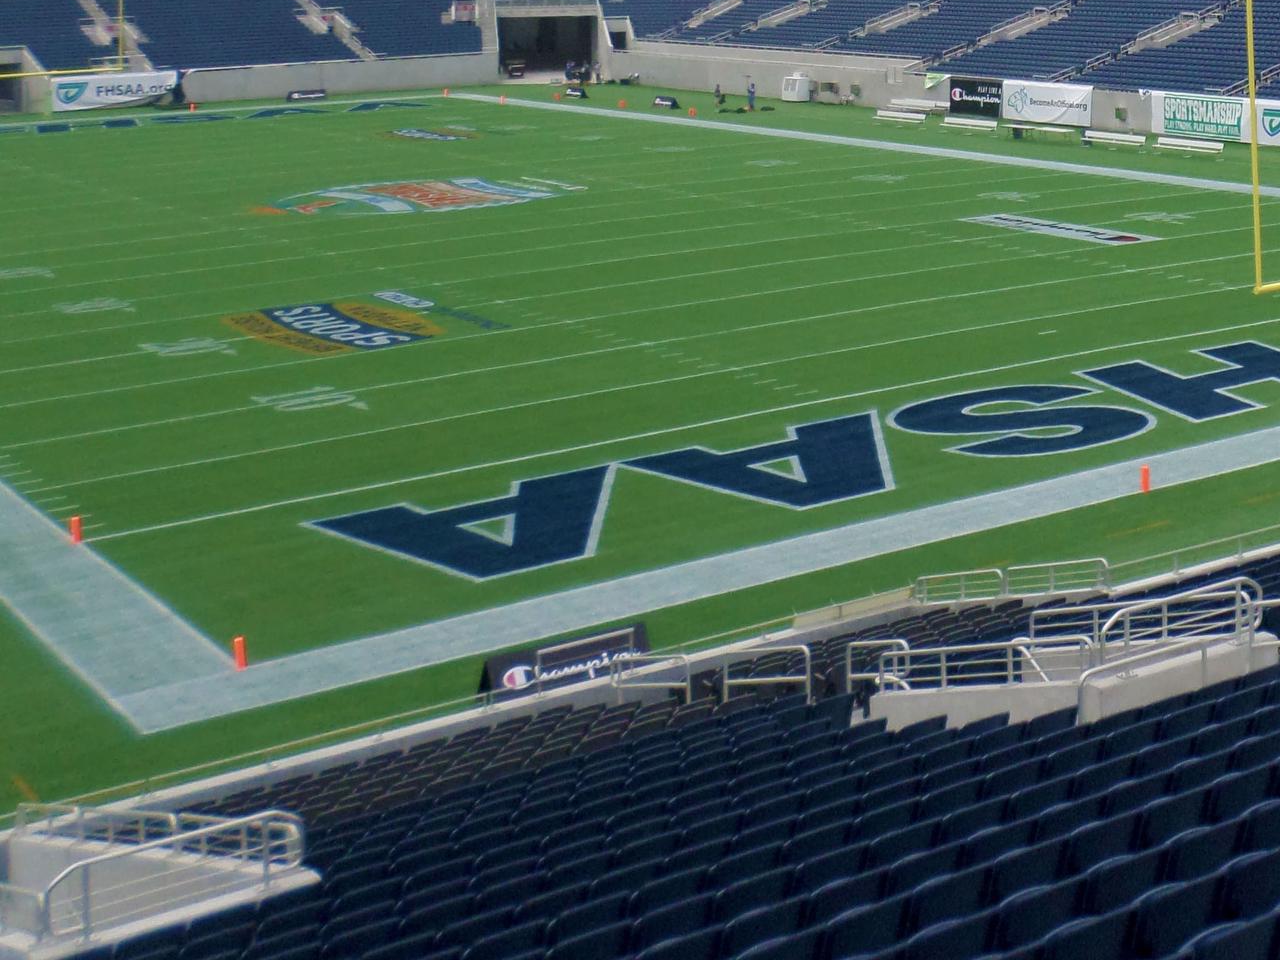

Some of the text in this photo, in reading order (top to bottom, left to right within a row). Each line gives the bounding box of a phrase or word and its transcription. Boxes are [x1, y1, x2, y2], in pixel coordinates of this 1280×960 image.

[951, 87, 1001, 107] Champion
[1164, 98, 1242, 125] SPORTSMANSHIP
[273, 306, 411, 346] SPORTS
